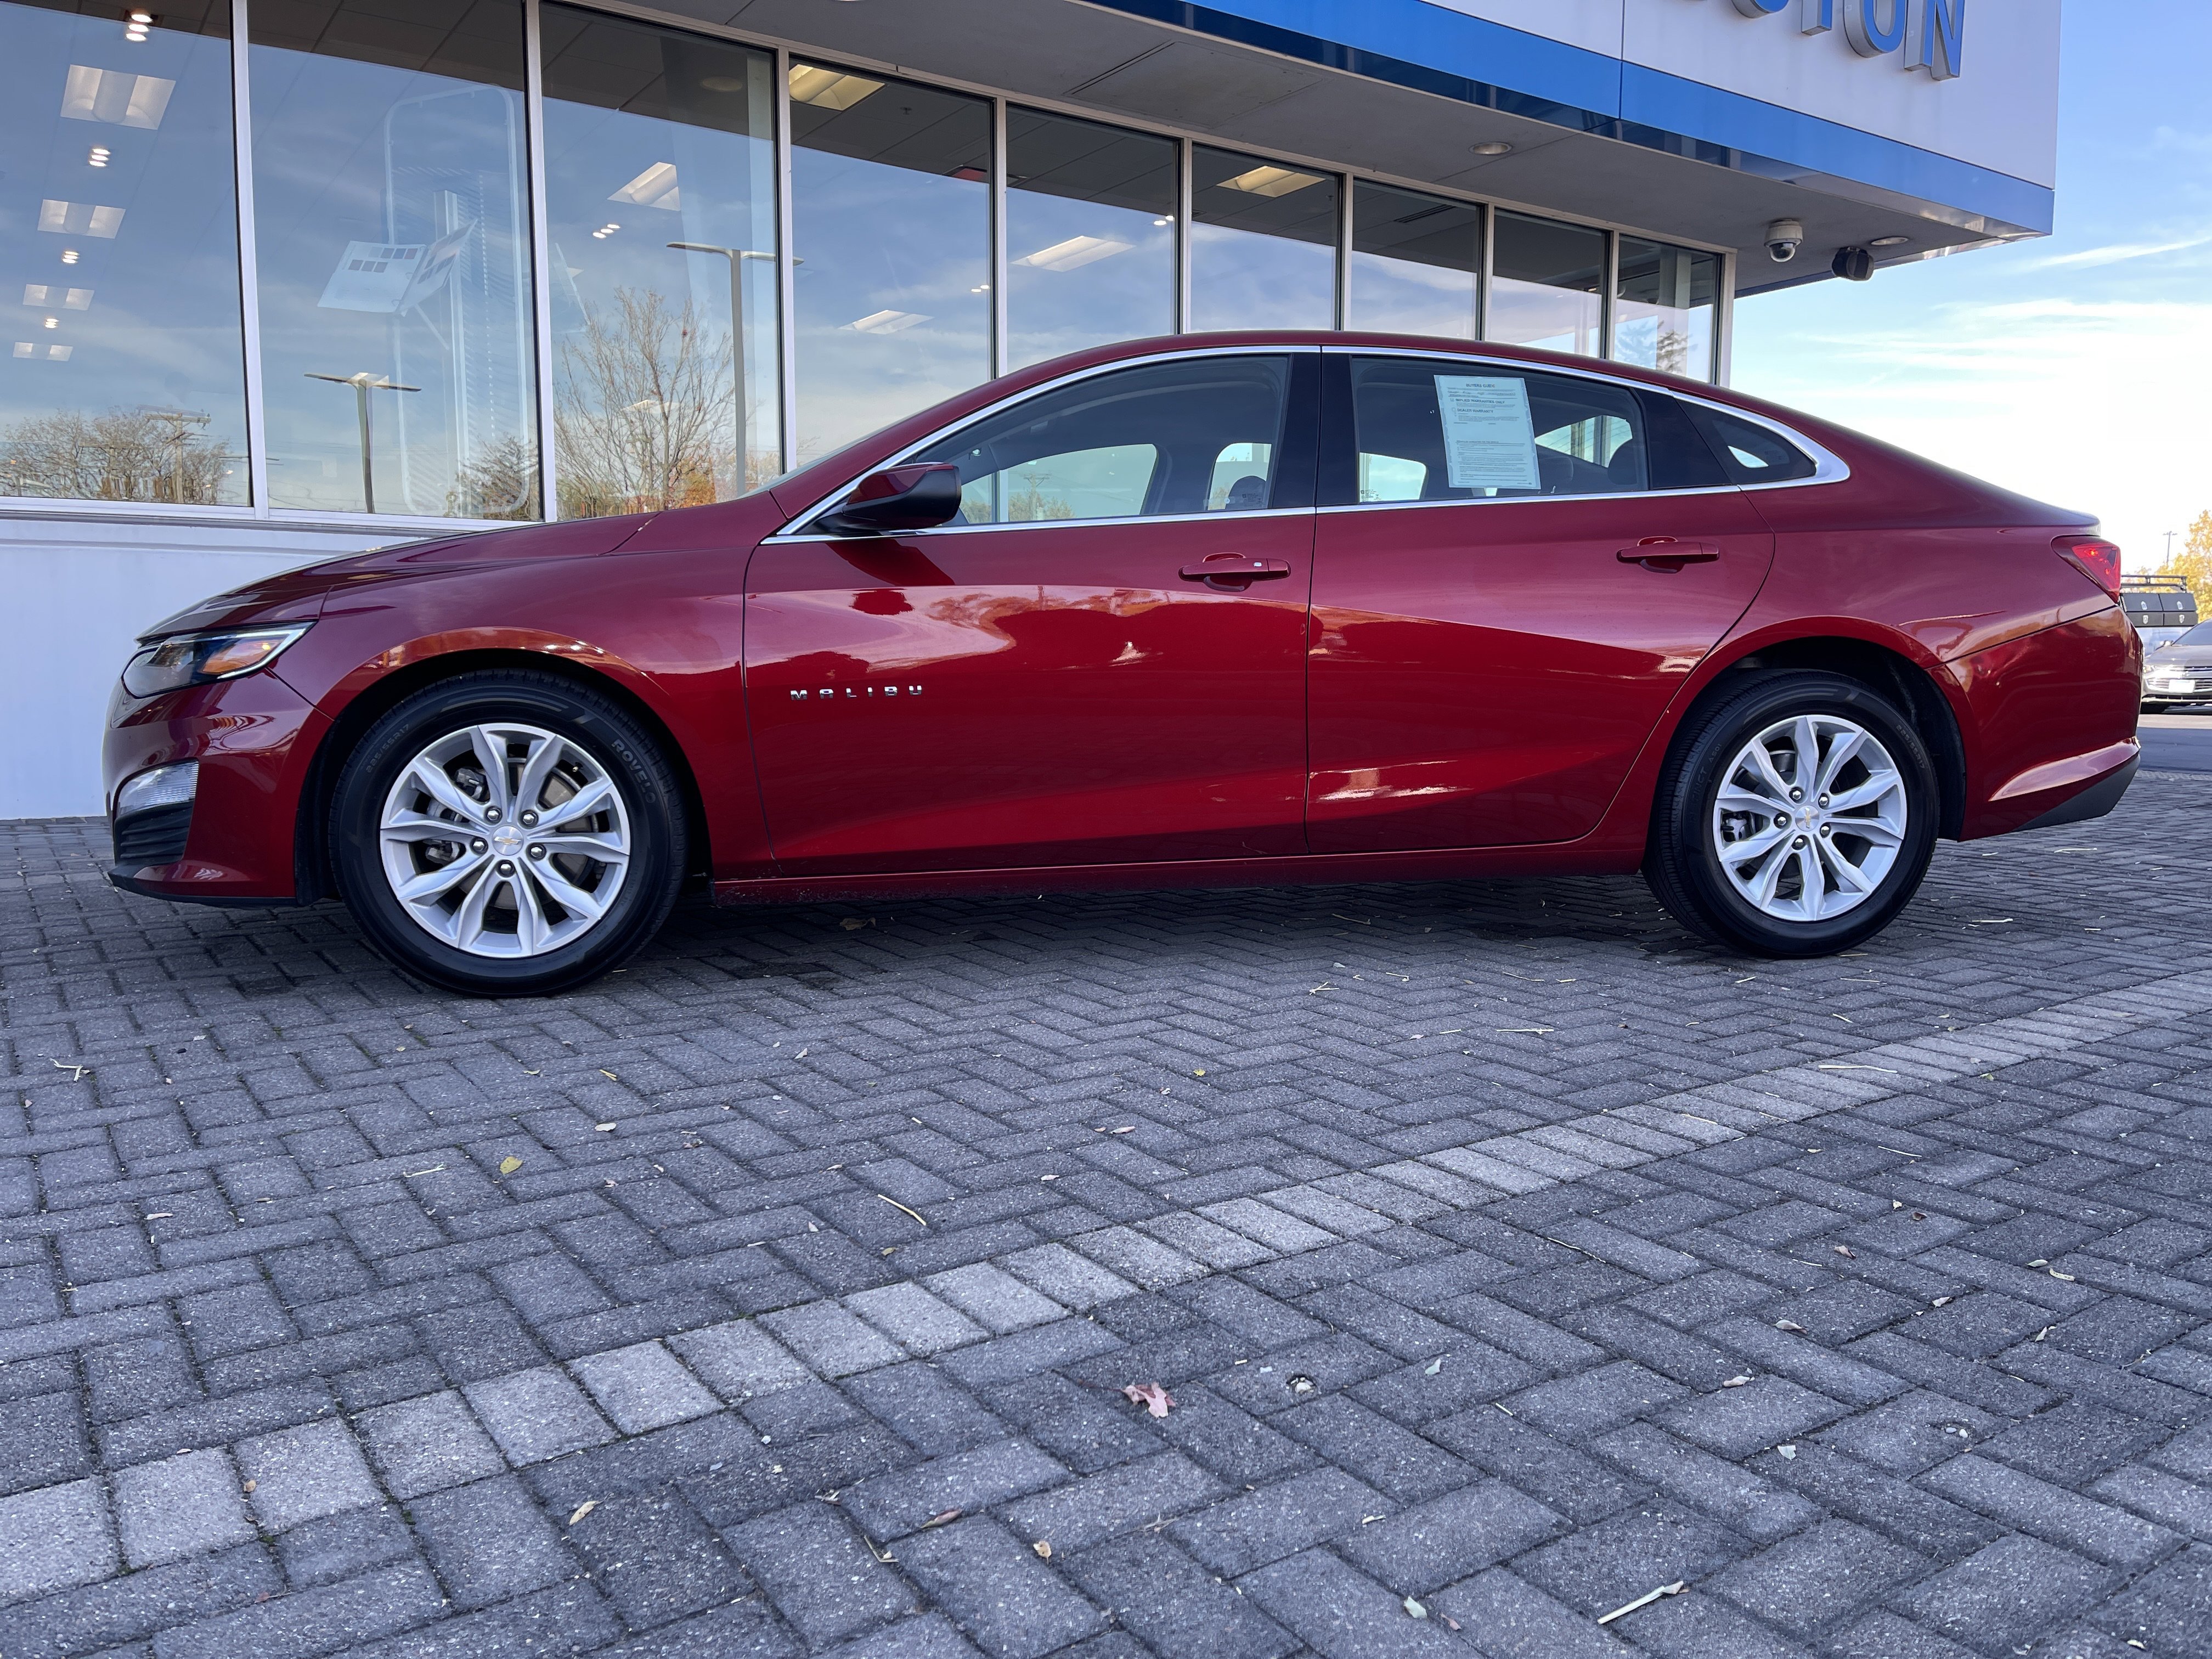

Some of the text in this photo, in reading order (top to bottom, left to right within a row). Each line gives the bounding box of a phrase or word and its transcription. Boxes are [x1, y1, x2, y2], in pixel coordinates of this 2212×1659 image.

[790, 685, 922, 700] MALIBU
[365, 724, 409, 772] 225/55R17
[611, 739, 656, 803] ROVELO
